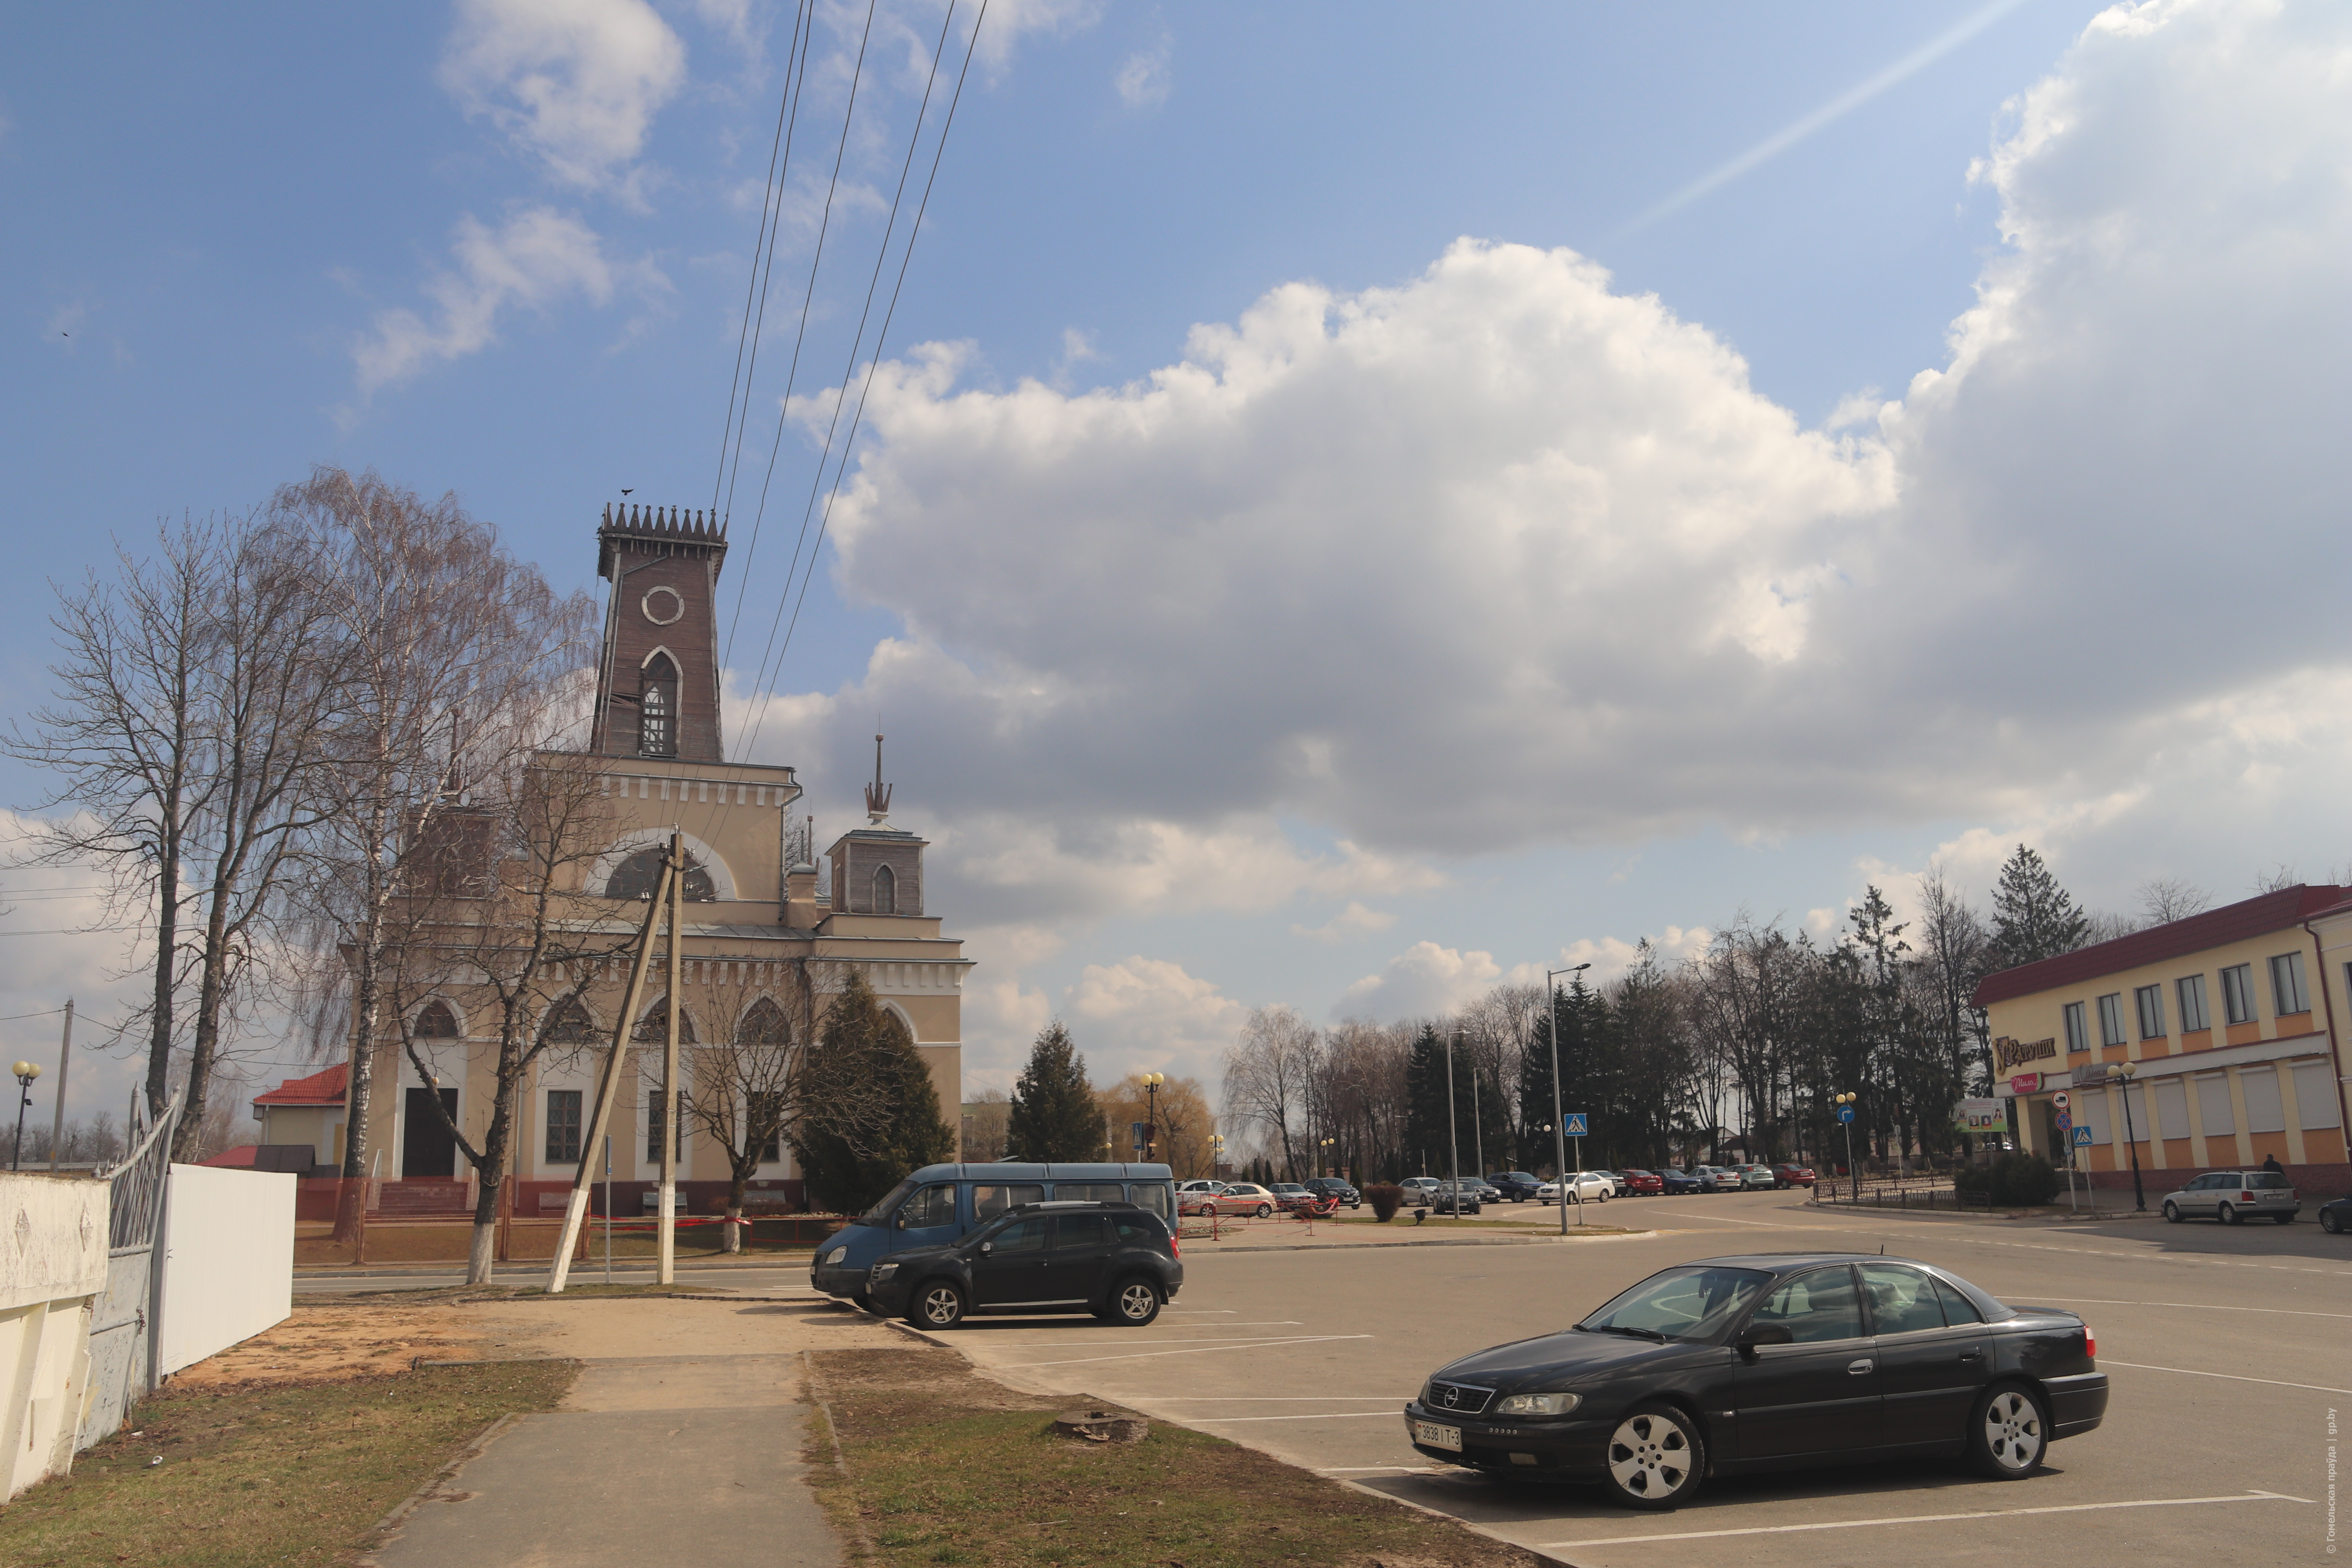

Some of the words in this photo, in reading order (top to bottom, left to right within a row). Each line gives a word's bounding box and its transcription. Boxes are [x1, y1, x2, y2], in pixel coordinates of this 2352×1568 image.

[1992, 1039, 2009, 1075] У
[2015, 1077, 2037, 1090] Мила
[1422, 1425, 1439, 1441] 3838
